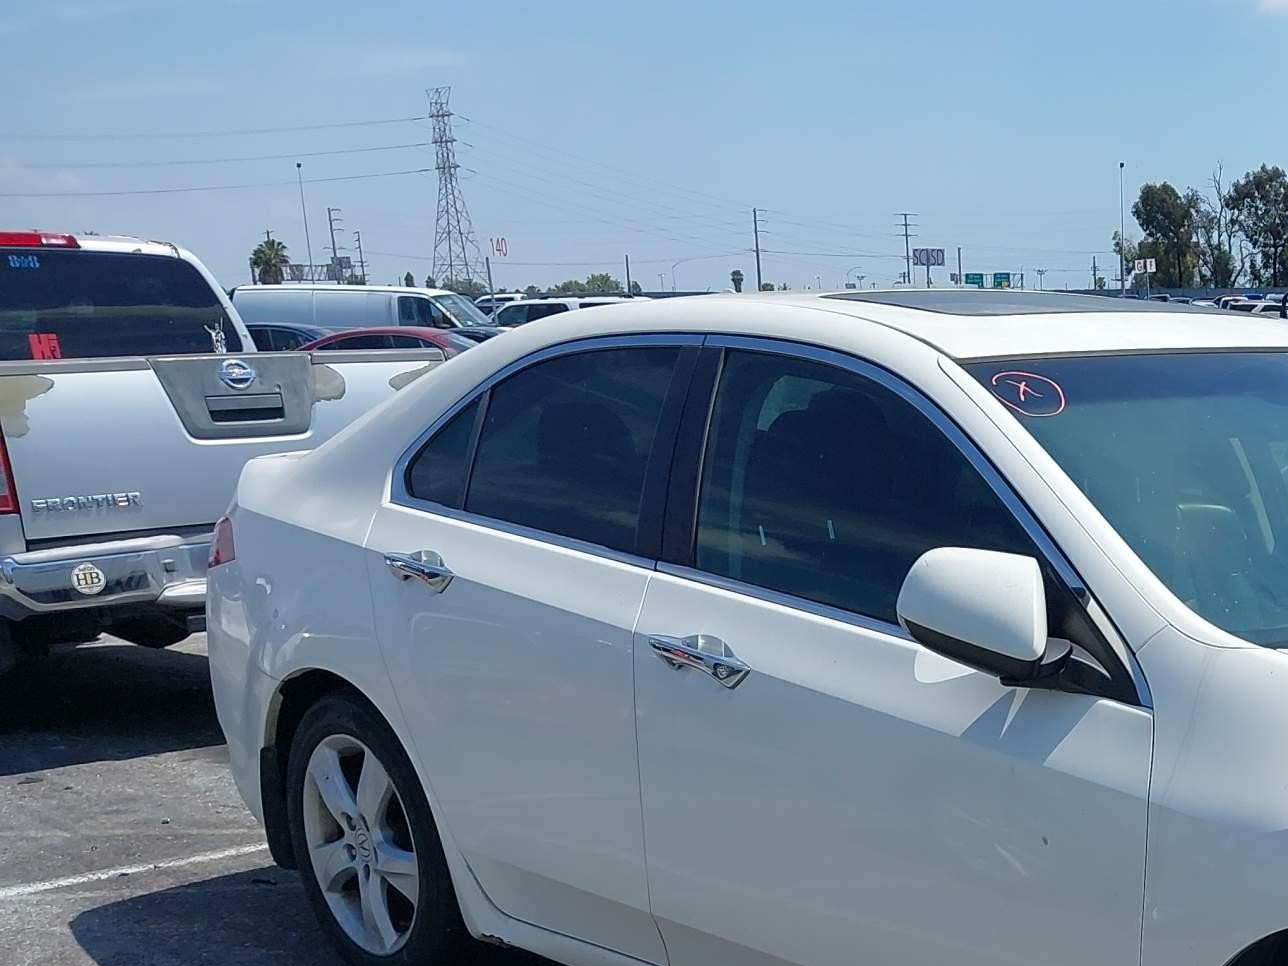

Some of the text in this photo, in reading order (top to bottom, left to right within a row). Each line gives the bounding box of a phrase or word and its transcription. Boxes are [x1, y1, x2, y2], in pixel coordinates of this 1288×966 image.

[490, 237, 508, 257] 140
[31, 491, 145, 513] FRONTIER
[74, 571, 101, 586] HB
